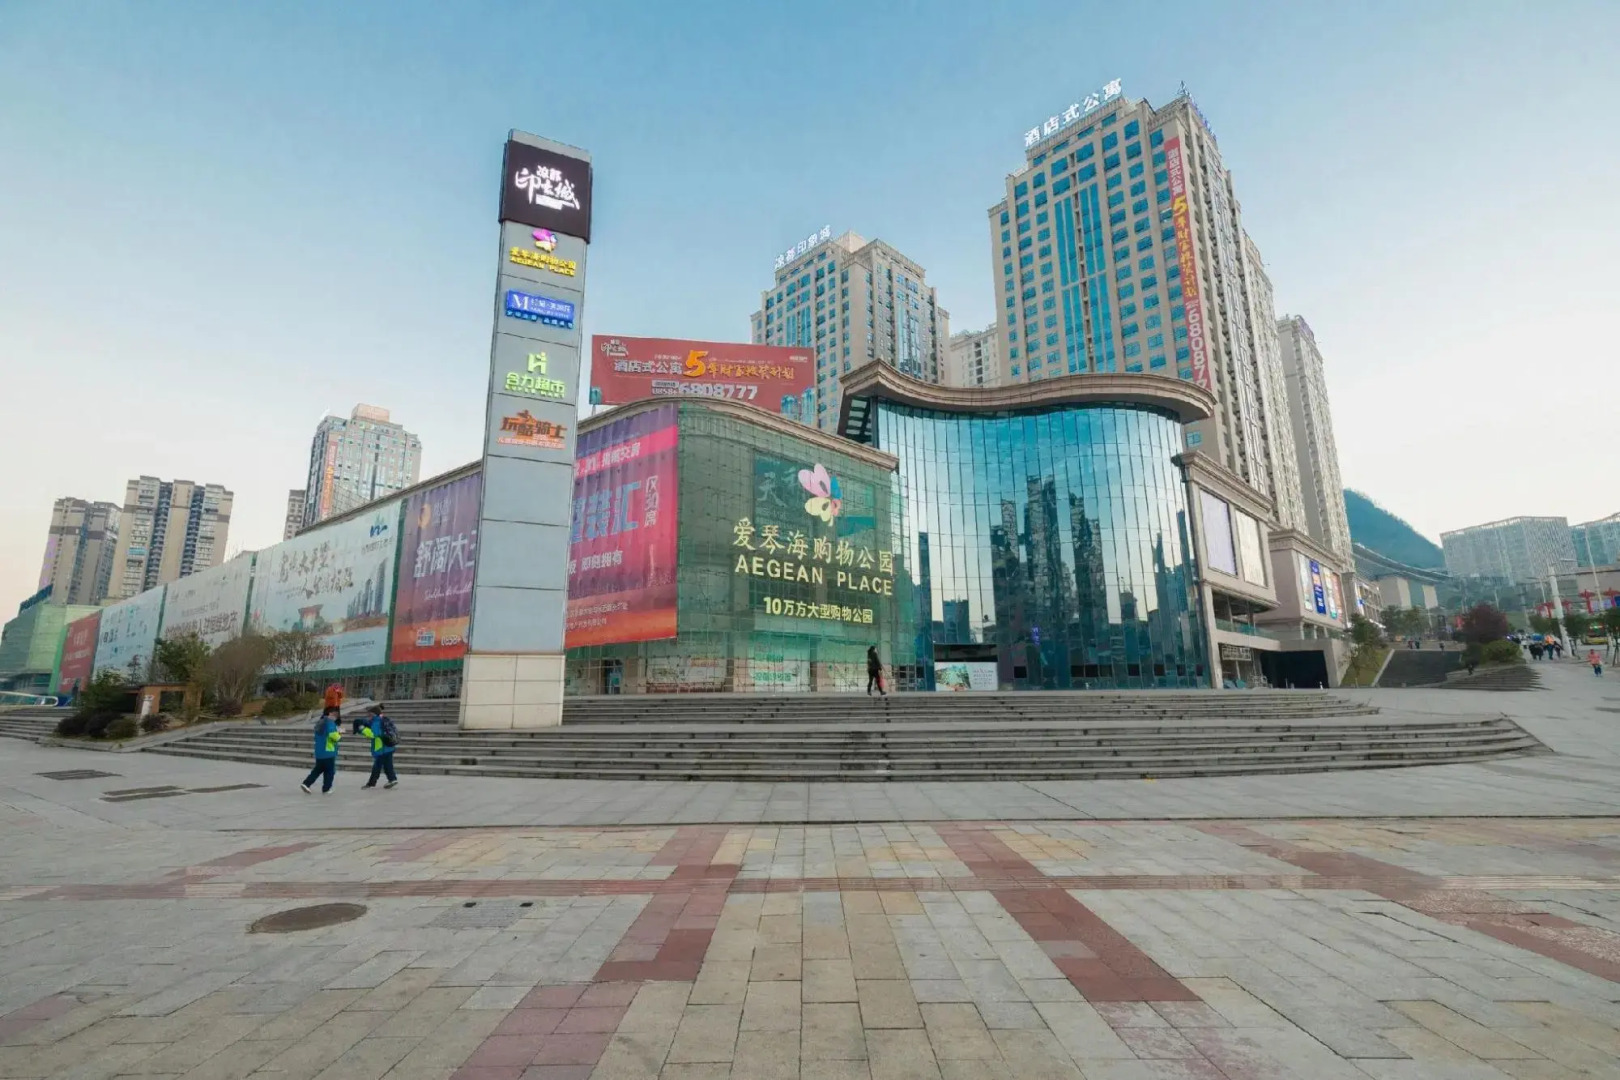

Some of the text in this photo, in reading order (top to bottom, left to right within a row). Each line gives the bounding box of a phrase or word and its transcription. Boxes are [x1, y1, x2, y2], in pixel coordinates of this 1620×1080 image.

[1024, 77, 1122, 147] 酒店式公寓
[510, 256, 545, 269] AEGEAN
[614, 359, 683, 374] 酒店式公寓
[506, 372, 565, 393] 合力超市
[678, 381, 758, 400] 6808777
[732, 517, 894, 576] 爱琴海购物公园
[735, 554, 894, 596] AEGEAN PLACE
[763, 596, 873, 624] 10万方大型购物公园
